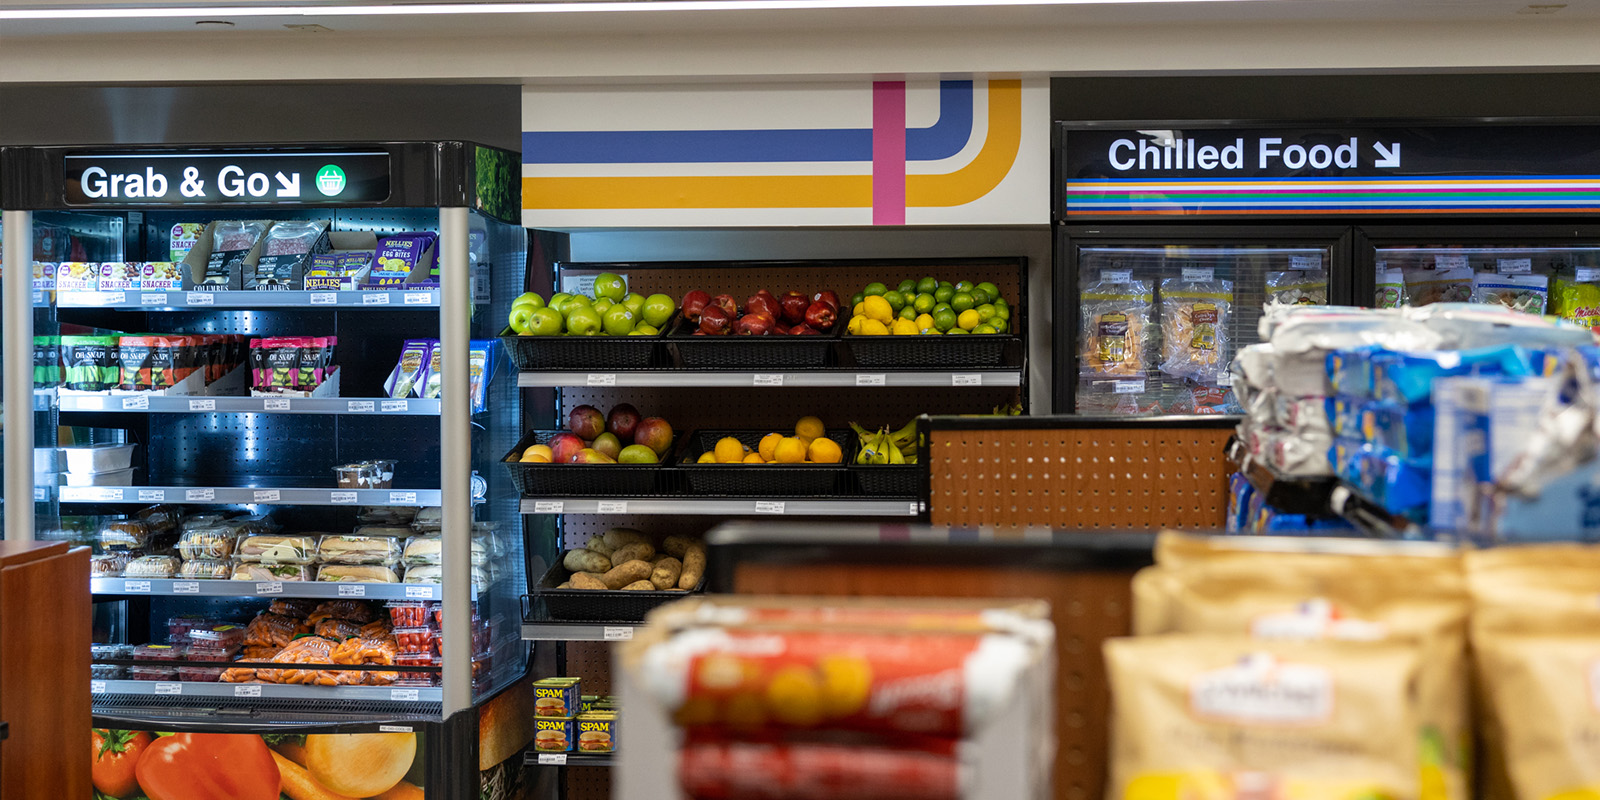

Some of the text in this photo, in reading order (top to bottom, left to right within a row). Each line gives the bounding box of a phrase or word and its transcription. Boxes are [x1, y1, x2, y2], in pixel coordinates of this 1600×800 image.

[1108, 137, 1358, 170] Chilled Food
[80, 165, 270, 198] Grab & Go
[58, 281, 87, 289] SNACKER
[536, 689, 563, 698] SPAM
[537, 721, 565, 730] SPAM
[580, 722, 609, 731] SPAM
